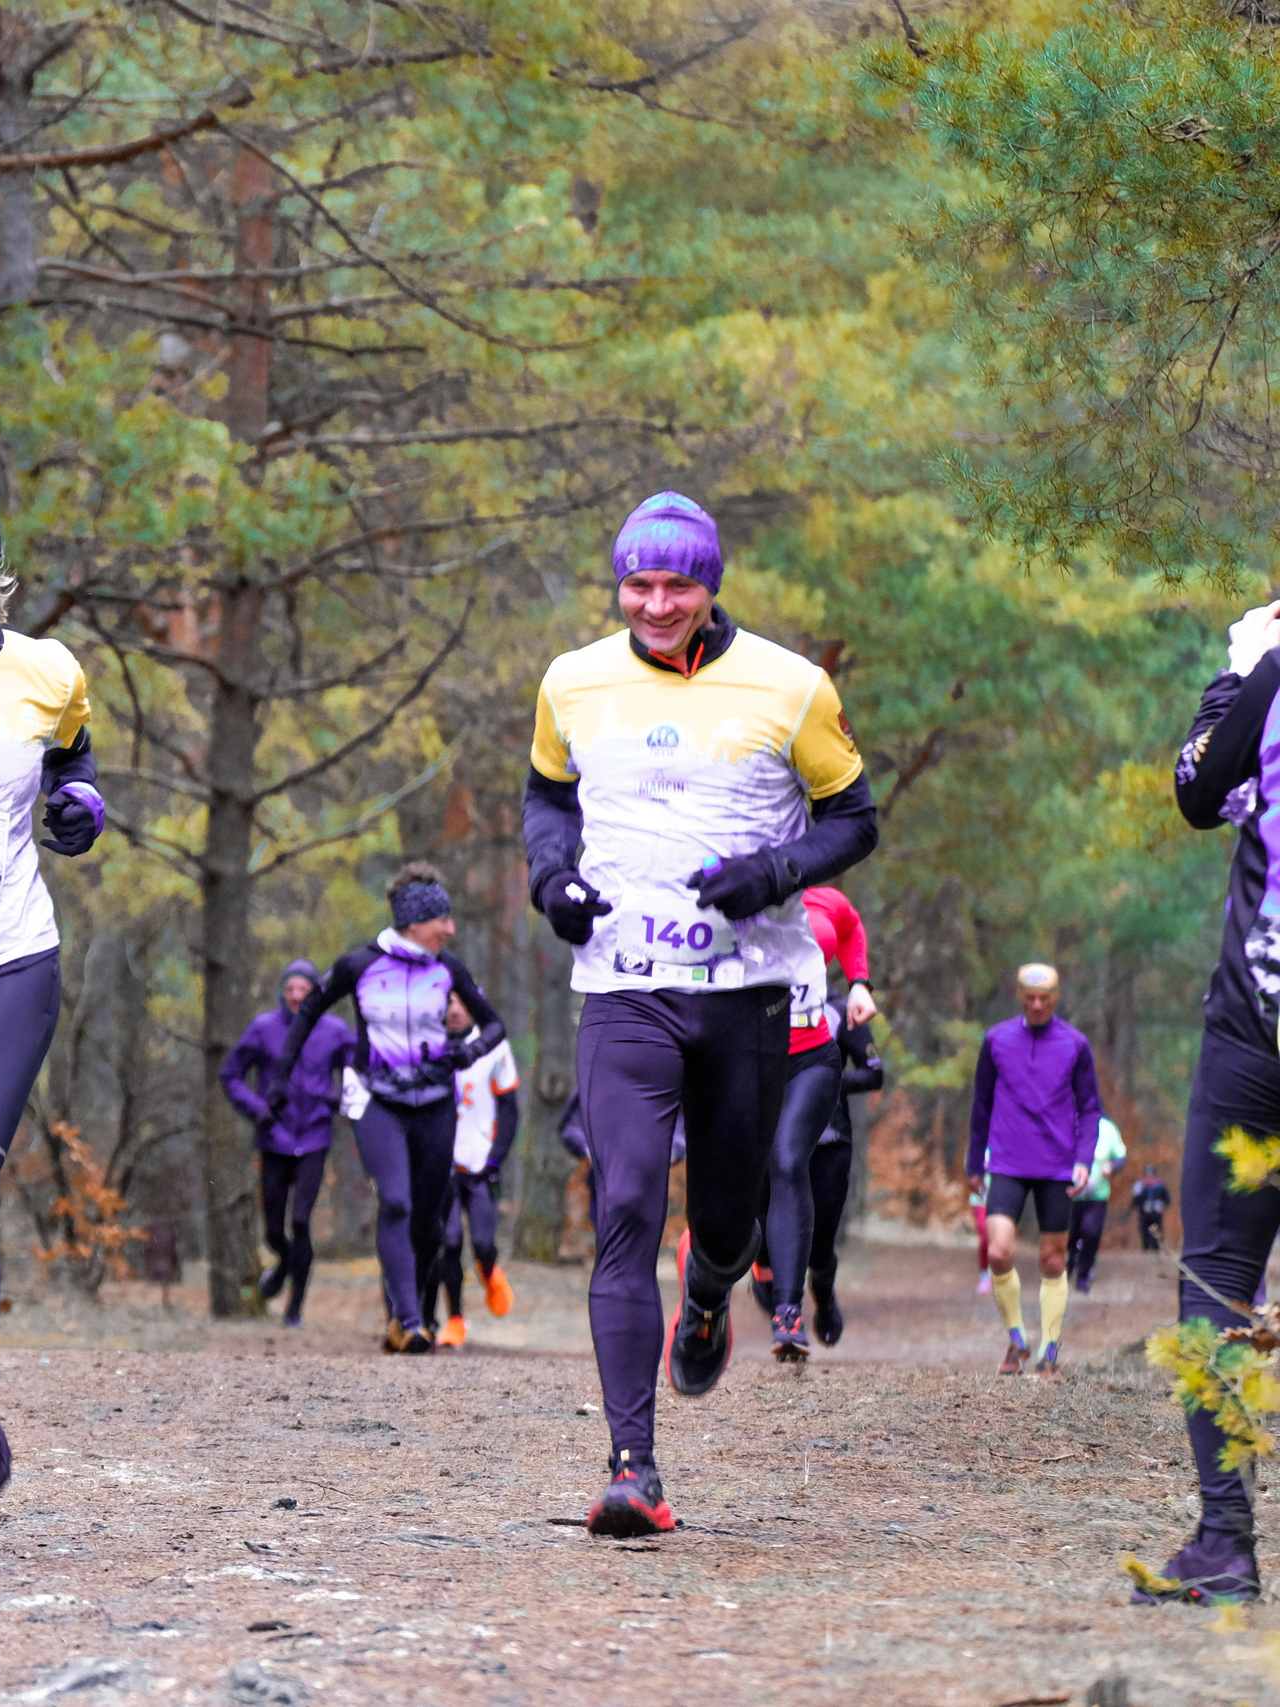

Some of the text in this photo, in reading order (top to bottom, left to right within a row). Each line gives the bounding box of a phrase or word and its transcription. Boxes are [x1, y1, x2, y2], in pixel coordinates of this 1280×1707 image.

[638, 780, 685, 796] MARCIN
[641, 915, 713, 951] 140
[790, 984, 810, 1003] 7
